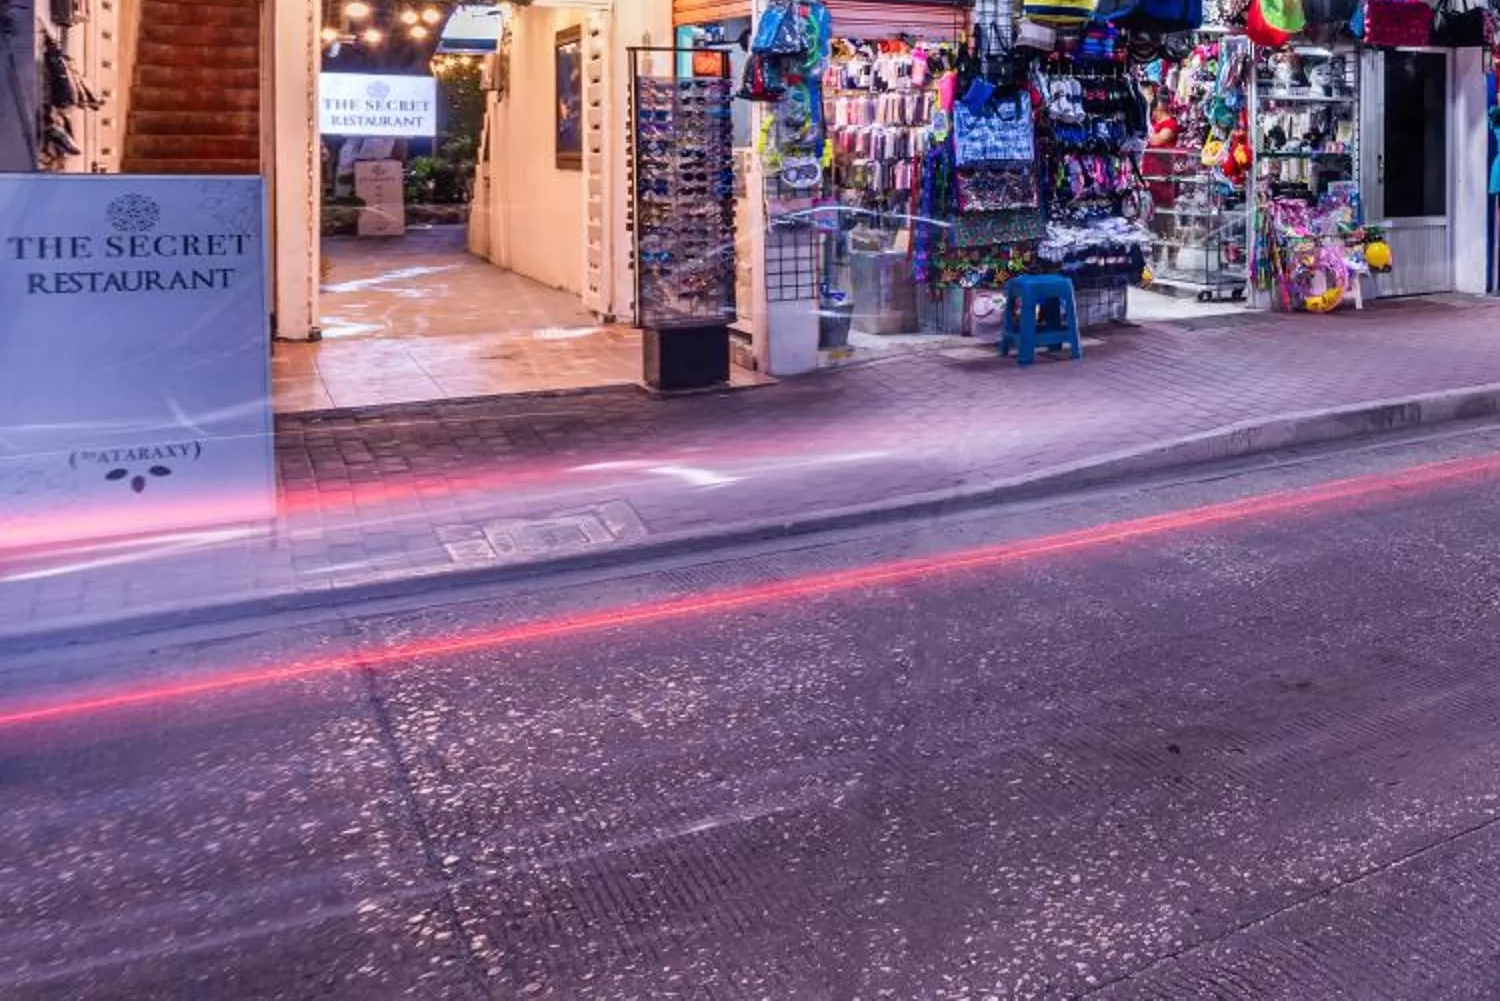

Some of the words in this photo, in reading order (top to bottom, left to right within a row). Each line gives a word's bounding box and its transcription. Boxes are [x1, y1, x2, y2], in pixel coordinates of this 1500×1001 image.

[324, 99, 357, 110] THE
[365, 100, 431, 112] SECRET
[331, 115, 425, 128] RESTAURANT
[8, 234, 93, 260] THE
[105, 232, 252, 259] SECRET
[27, 268, 236, 295] RESTAURANT
